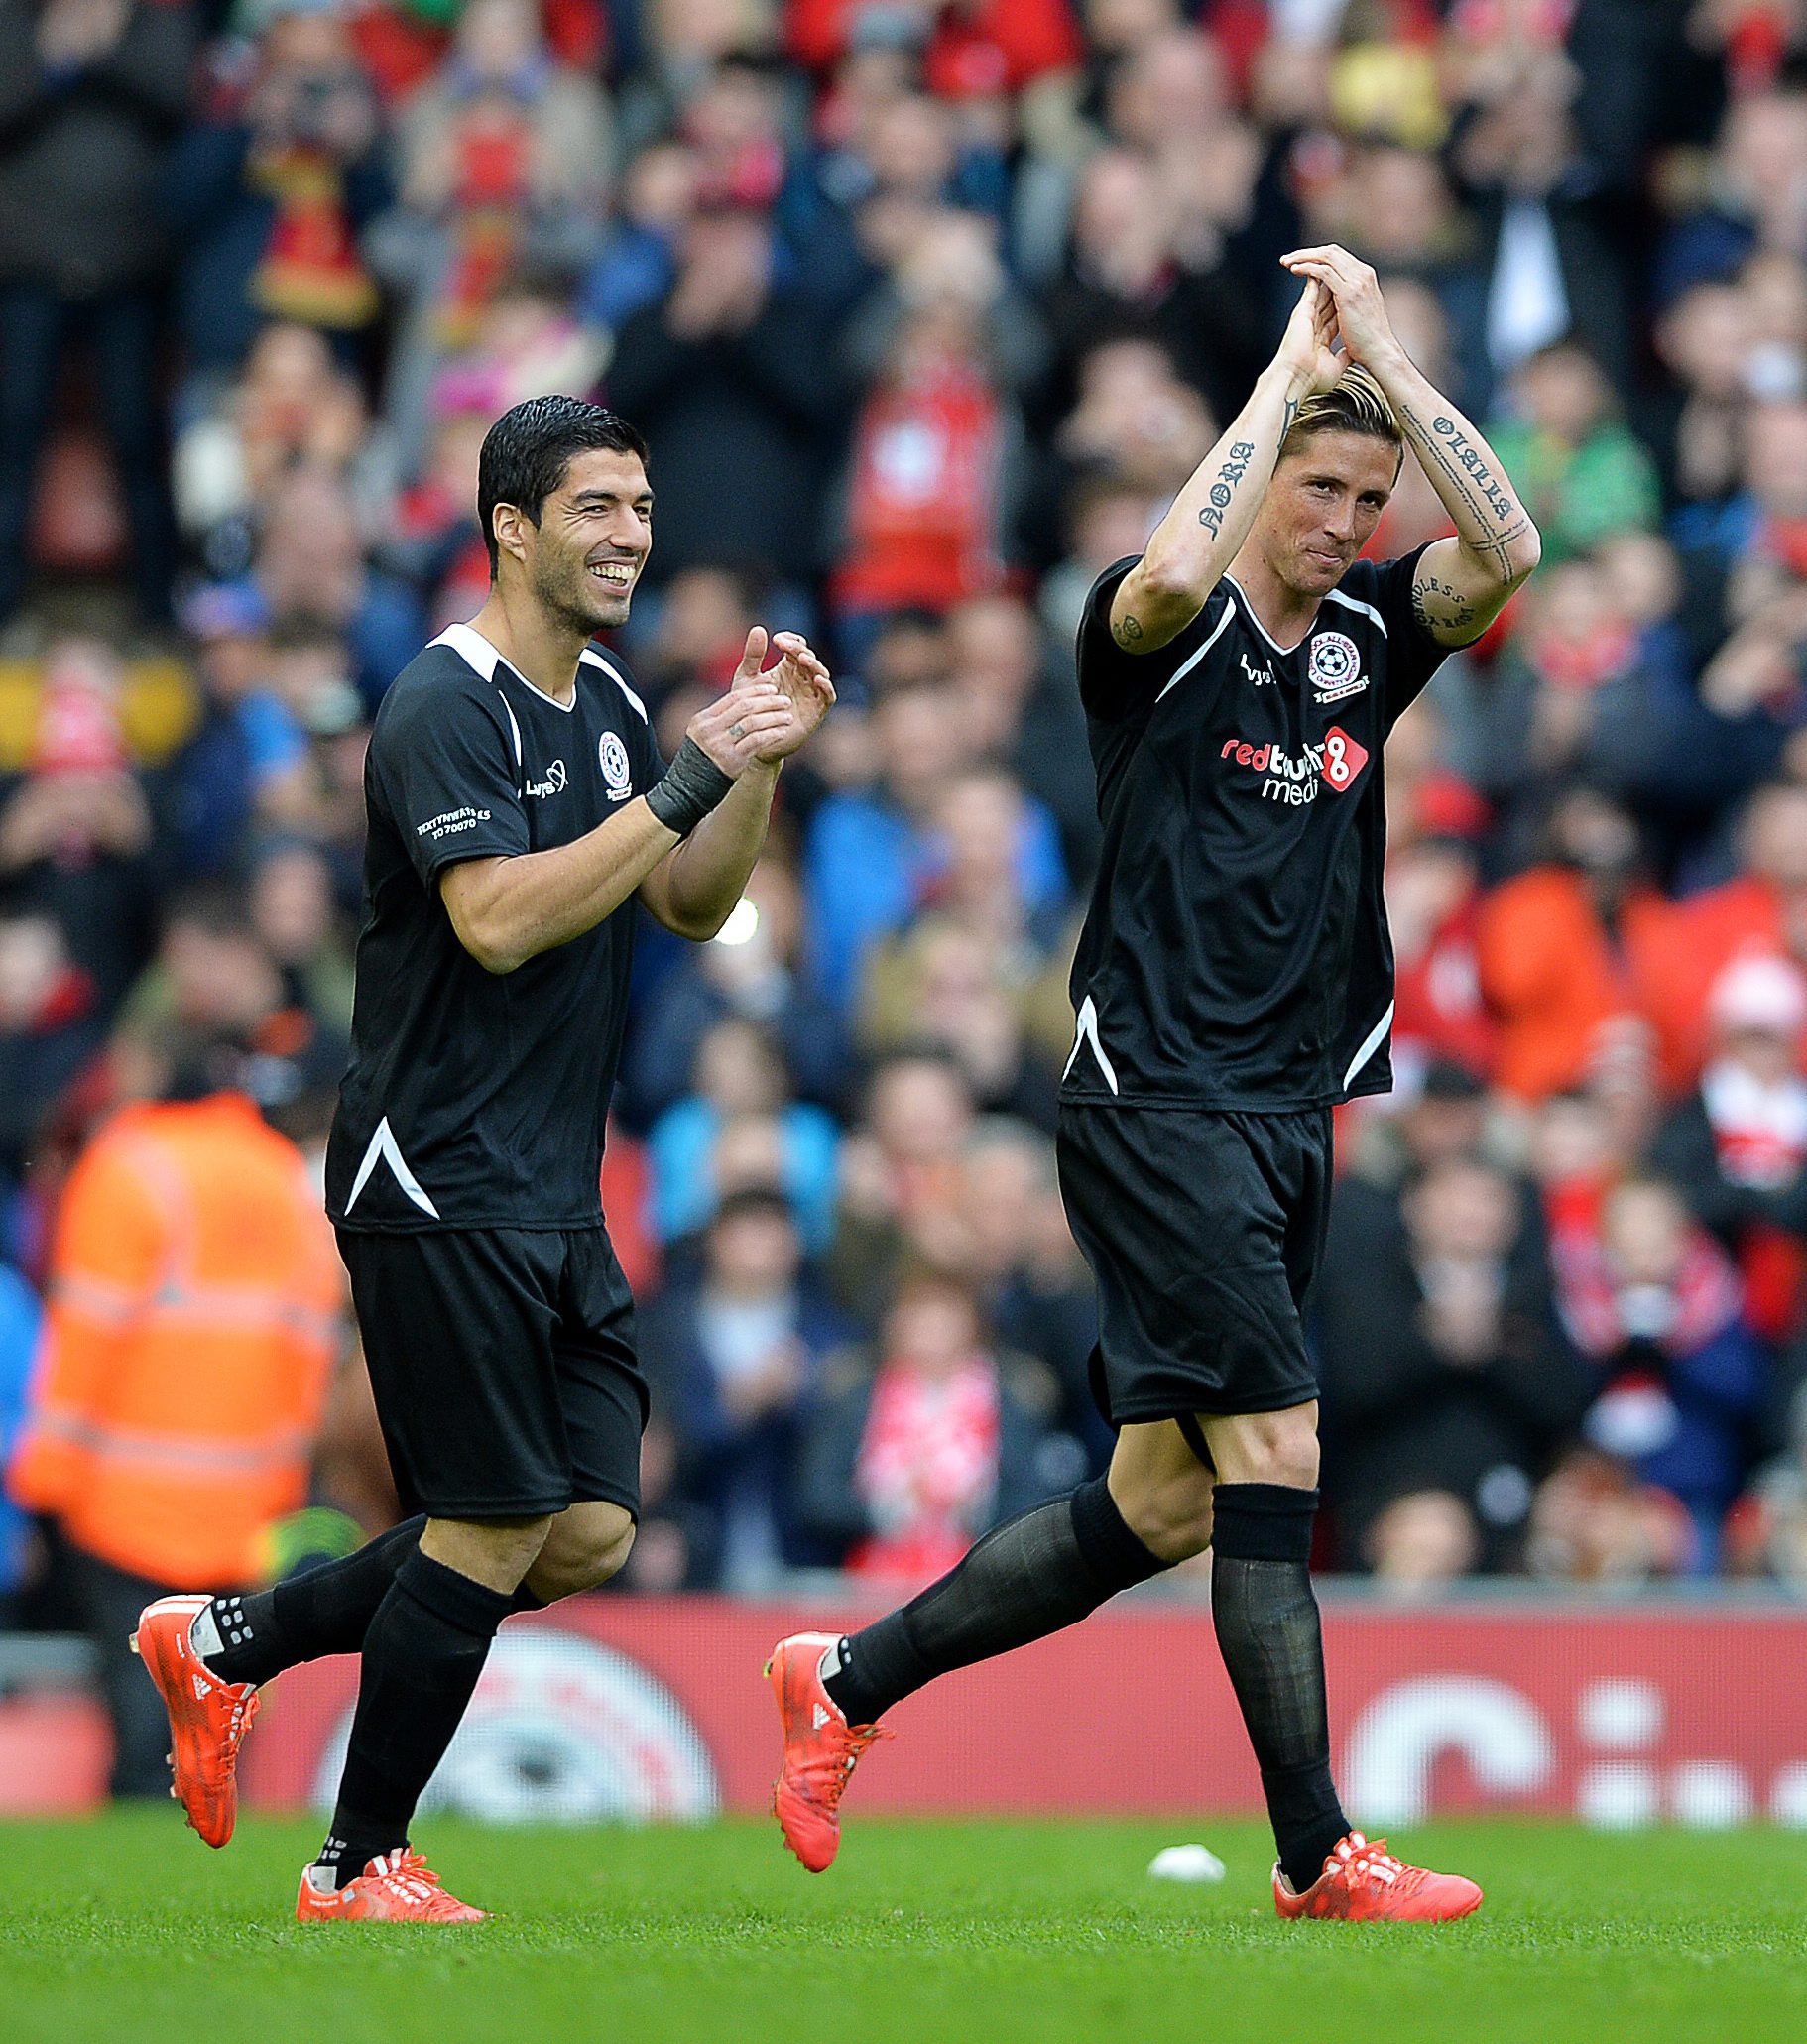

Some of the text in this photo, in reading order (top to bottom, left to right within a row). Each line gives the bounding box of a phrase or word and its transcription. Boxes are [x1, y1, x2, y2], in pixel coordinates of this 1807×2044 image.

[1198, 440, 1256, 542] NORA
[1432, 416, 1515, 522] OLALLA
[1220, 739, 1325, 782] redtuh
[431, 818, 477, 841] TO 70070
